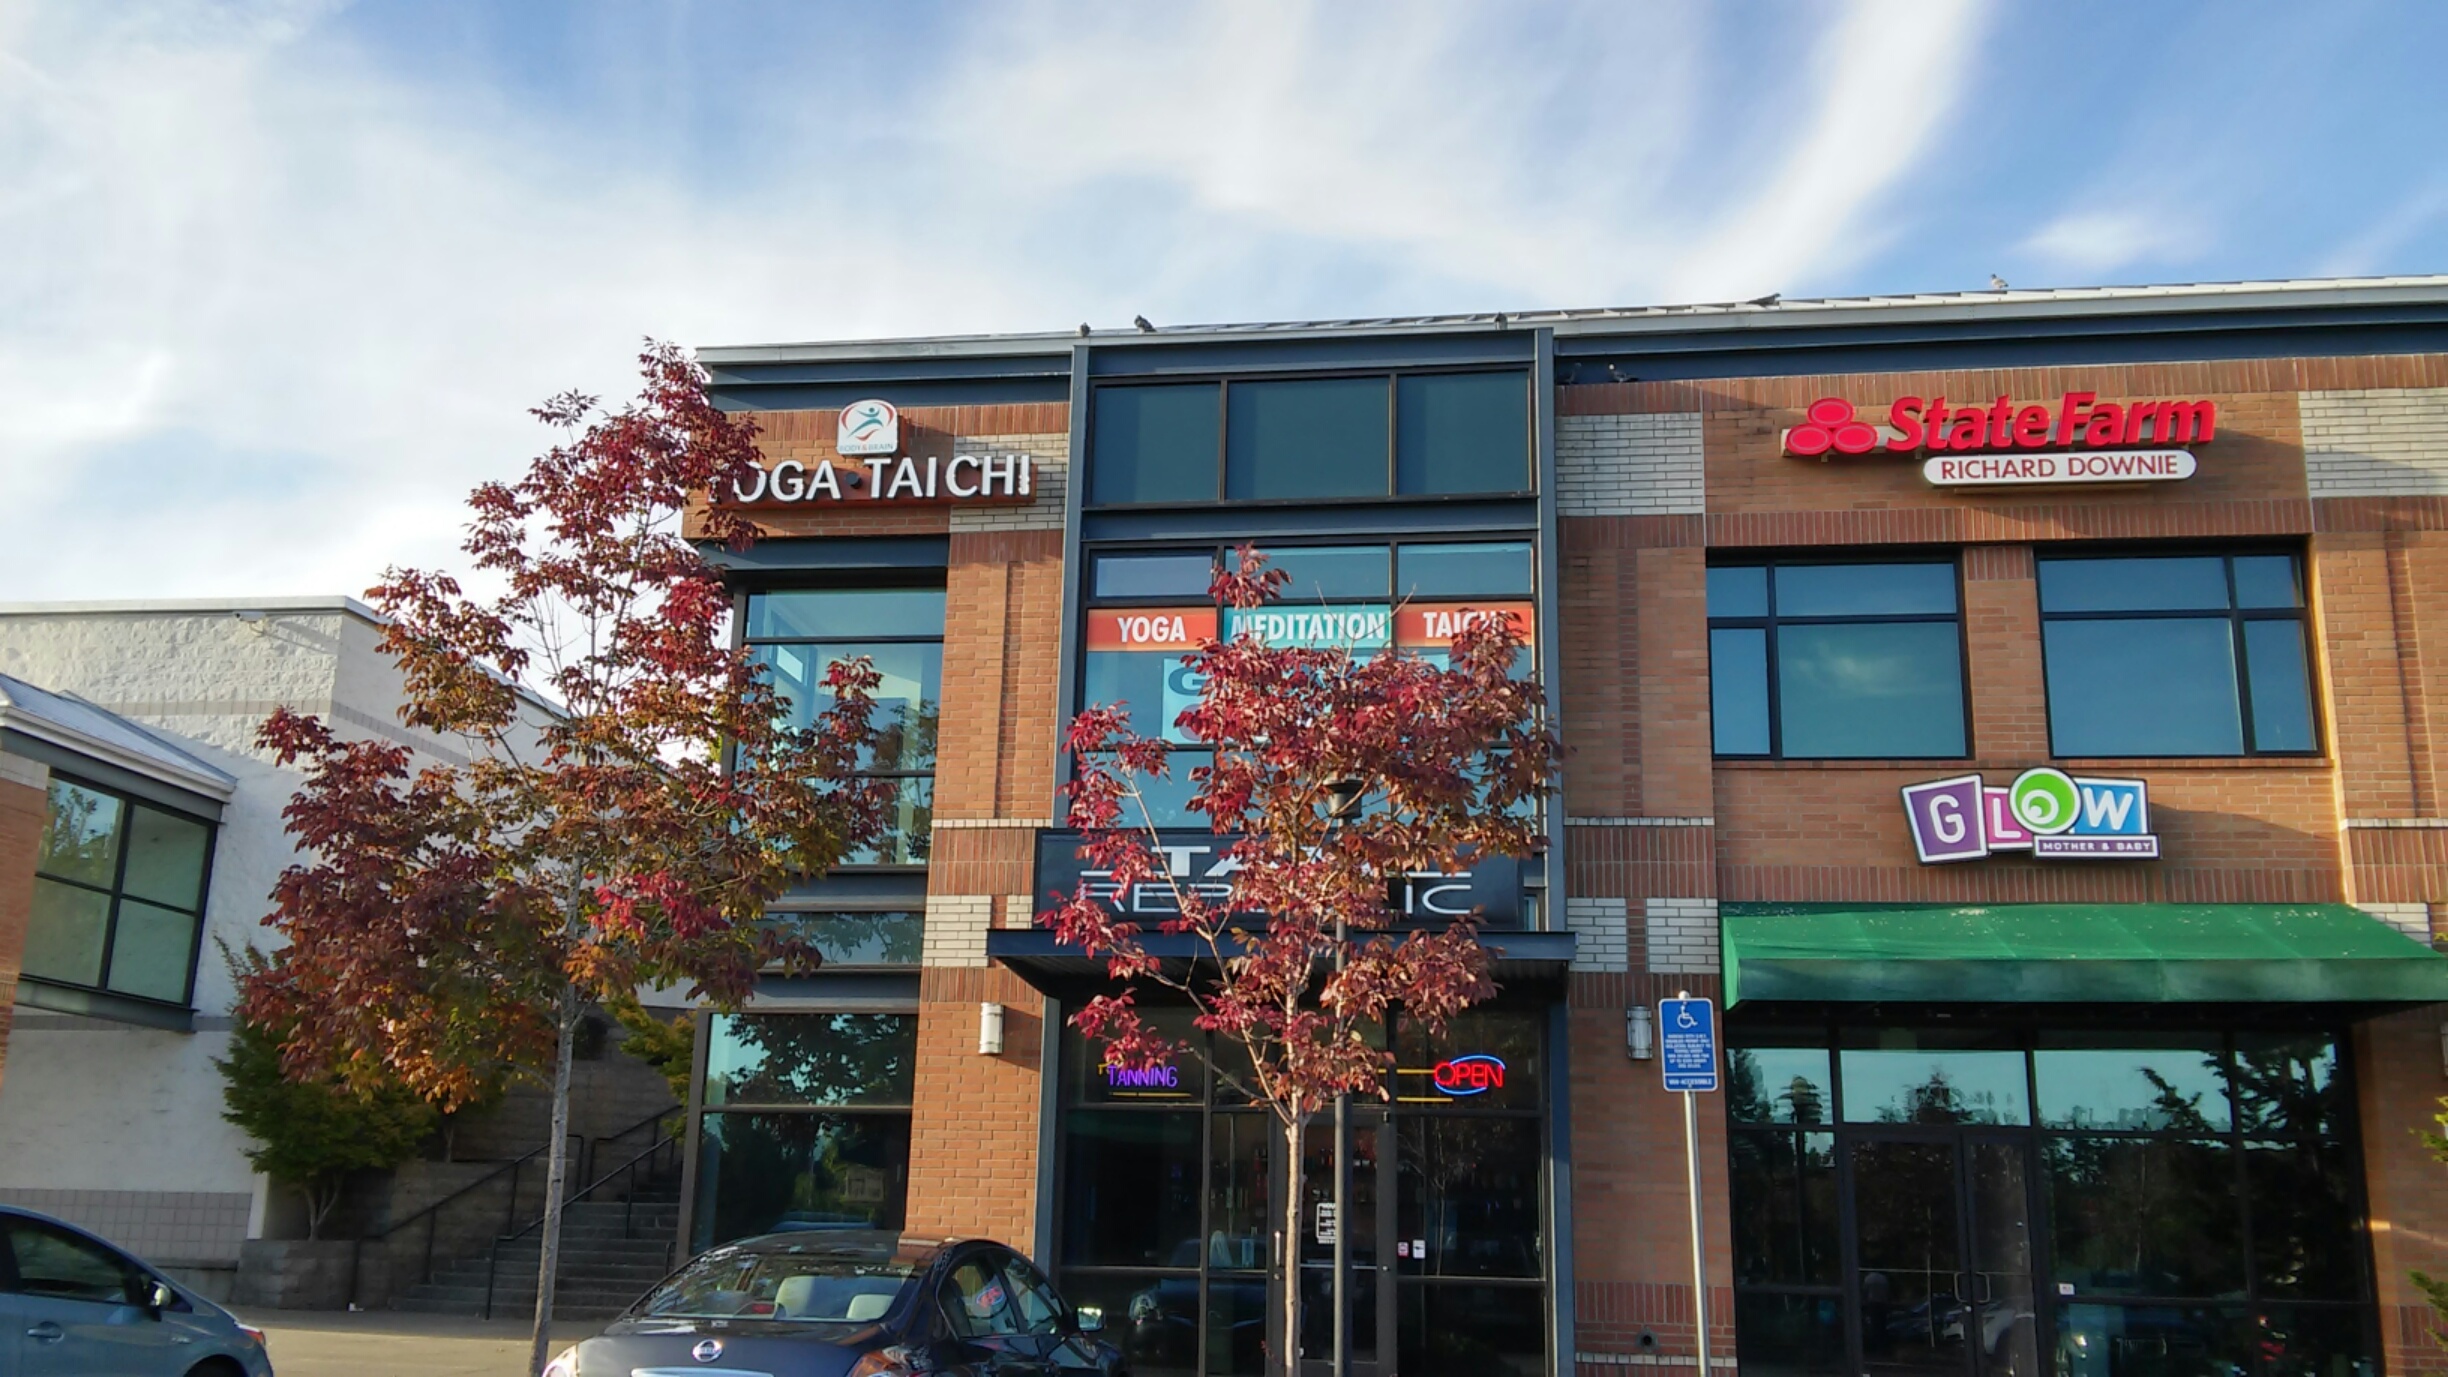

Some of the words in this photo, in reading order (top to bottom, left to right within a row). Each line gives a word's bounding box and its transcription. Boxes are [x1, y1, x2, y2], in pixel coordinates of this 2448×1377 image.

[1940, 458, 2056, 480] RICHARD
[2068, 455, 2178, 477] DOWNIE
[1117, 615, 1186, 643] YOGA
[1231, 612, 1385, 640] MEDITATION
[1422, 610, 1507, 638] TAIC
[1929, 786, 2134, 844] GLOW
[2042, 842, 2095, 851] MOTHER
[2101, 842, 2110, 851] &
[2116, 842, 2152, 851] BABY
[1107, 1065, 1178, 1088] TANNING
[1433, 1061, 1505, 1089] OPEN
